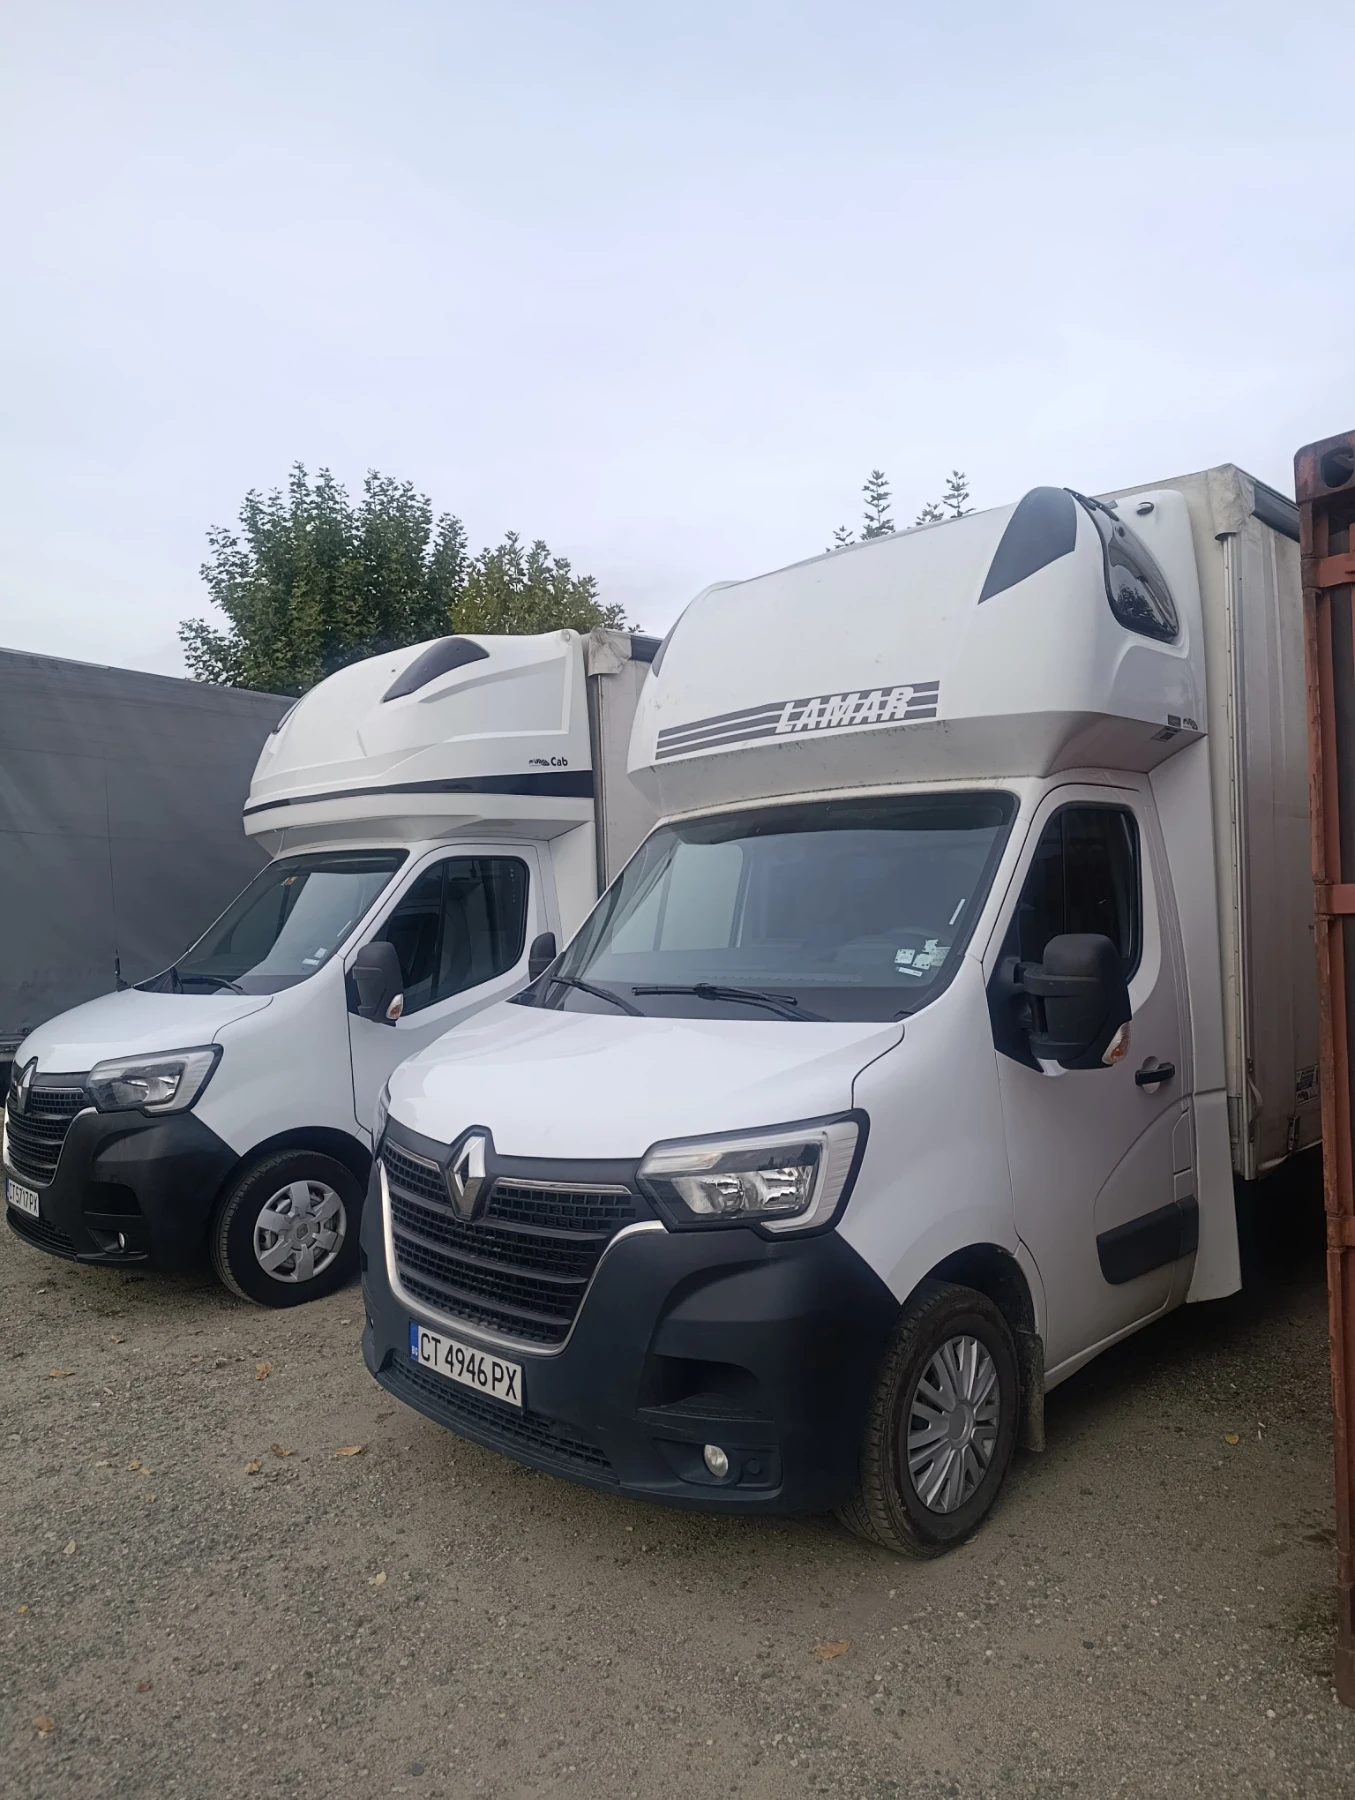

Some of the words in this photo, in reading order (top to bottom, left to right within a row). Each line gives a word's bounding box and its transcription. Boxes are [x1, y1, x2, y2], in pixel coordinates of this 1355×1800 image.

[775, 686, 915, 734] LAMAR
[550, 756, 568, 767] Cab
[445, 1344, 488, 1387] 4946
